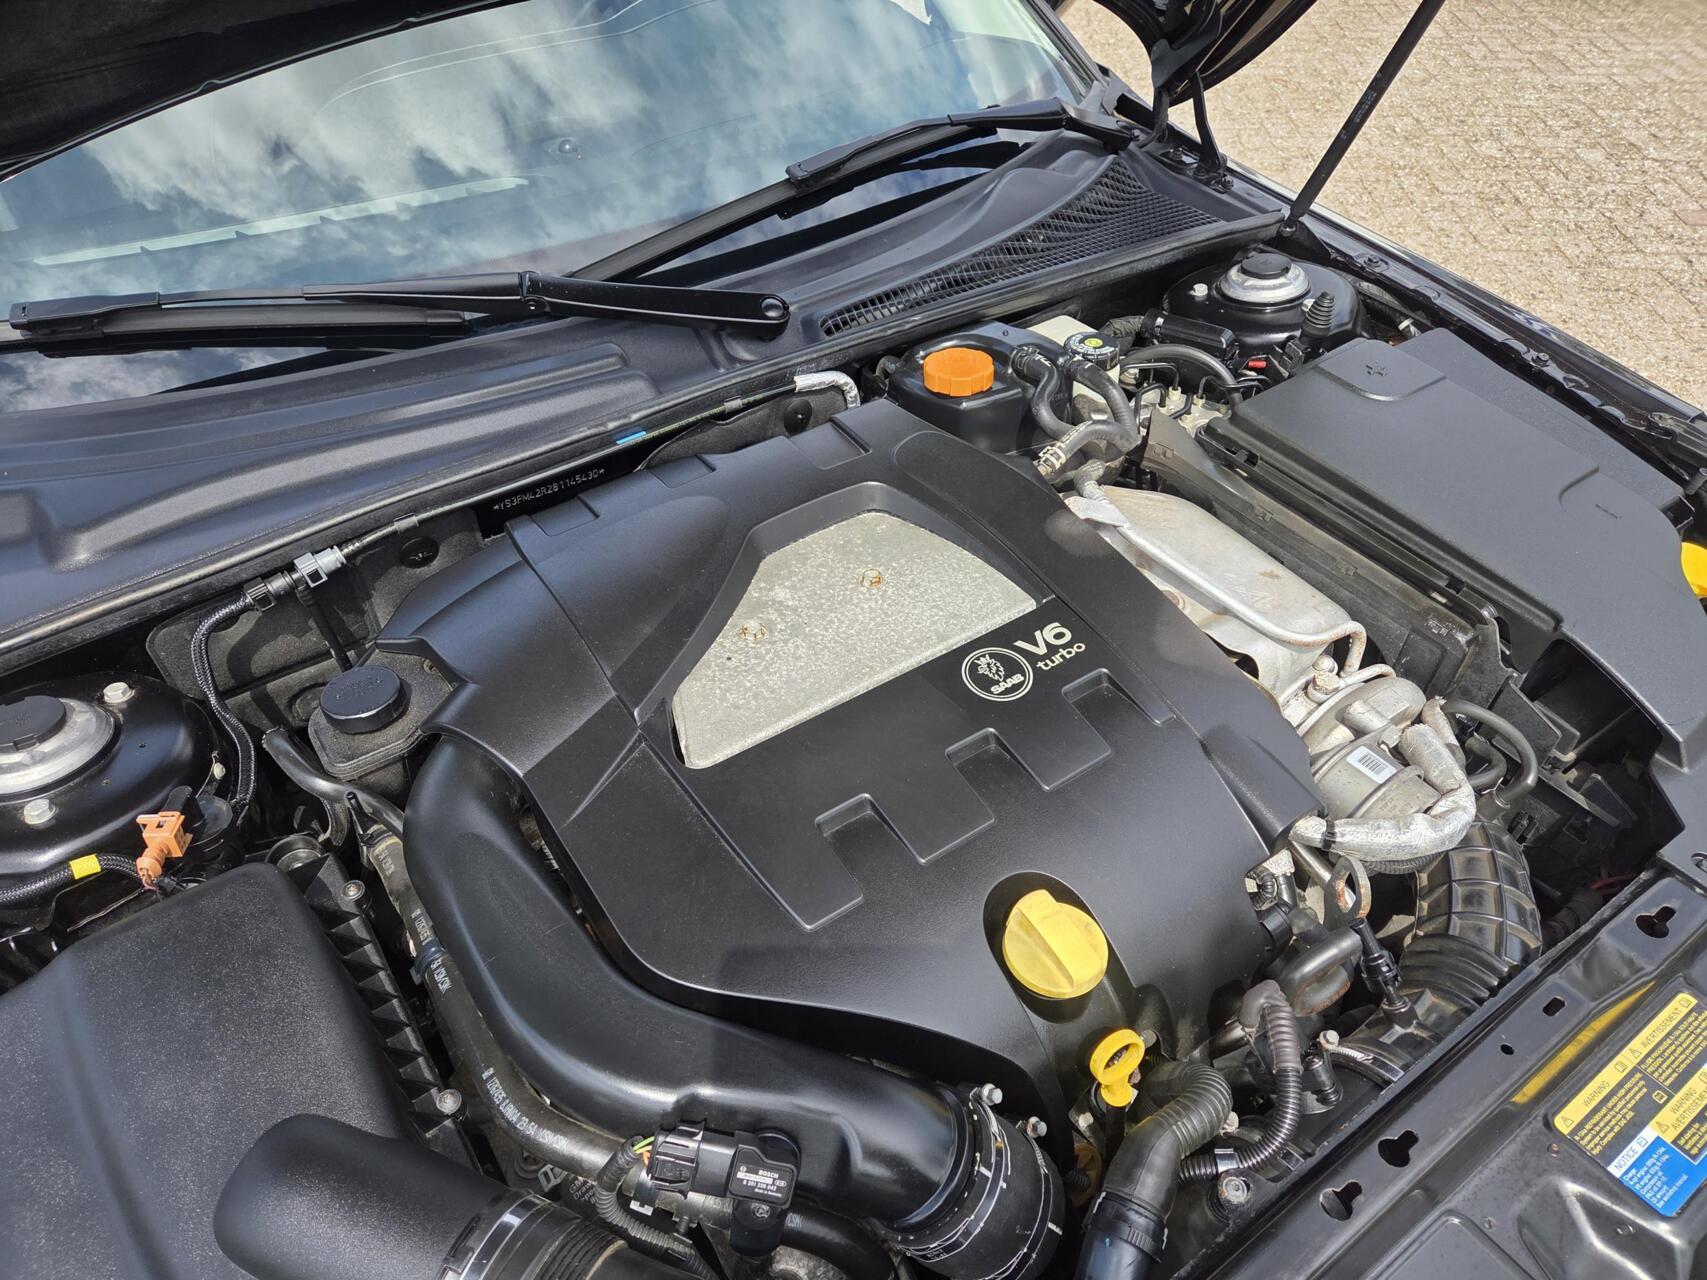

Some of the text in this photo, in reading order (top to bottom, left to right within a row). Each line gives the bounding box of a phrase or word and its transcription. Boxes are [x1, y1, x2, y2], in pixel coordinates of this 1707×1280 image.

[1013, 622, 1072, 655] V6
[1036, 642, 1086, 670] turbo
[990, 673, 1025, 695] SAAB
[1582, 1080, 1610, 1107] WARNING
[1668, 1086, 1698, 1114] WARNING
[1612, 1145, 1639, 1171] NOTICE
[758, 1169, 779, 1179] BOSCH
